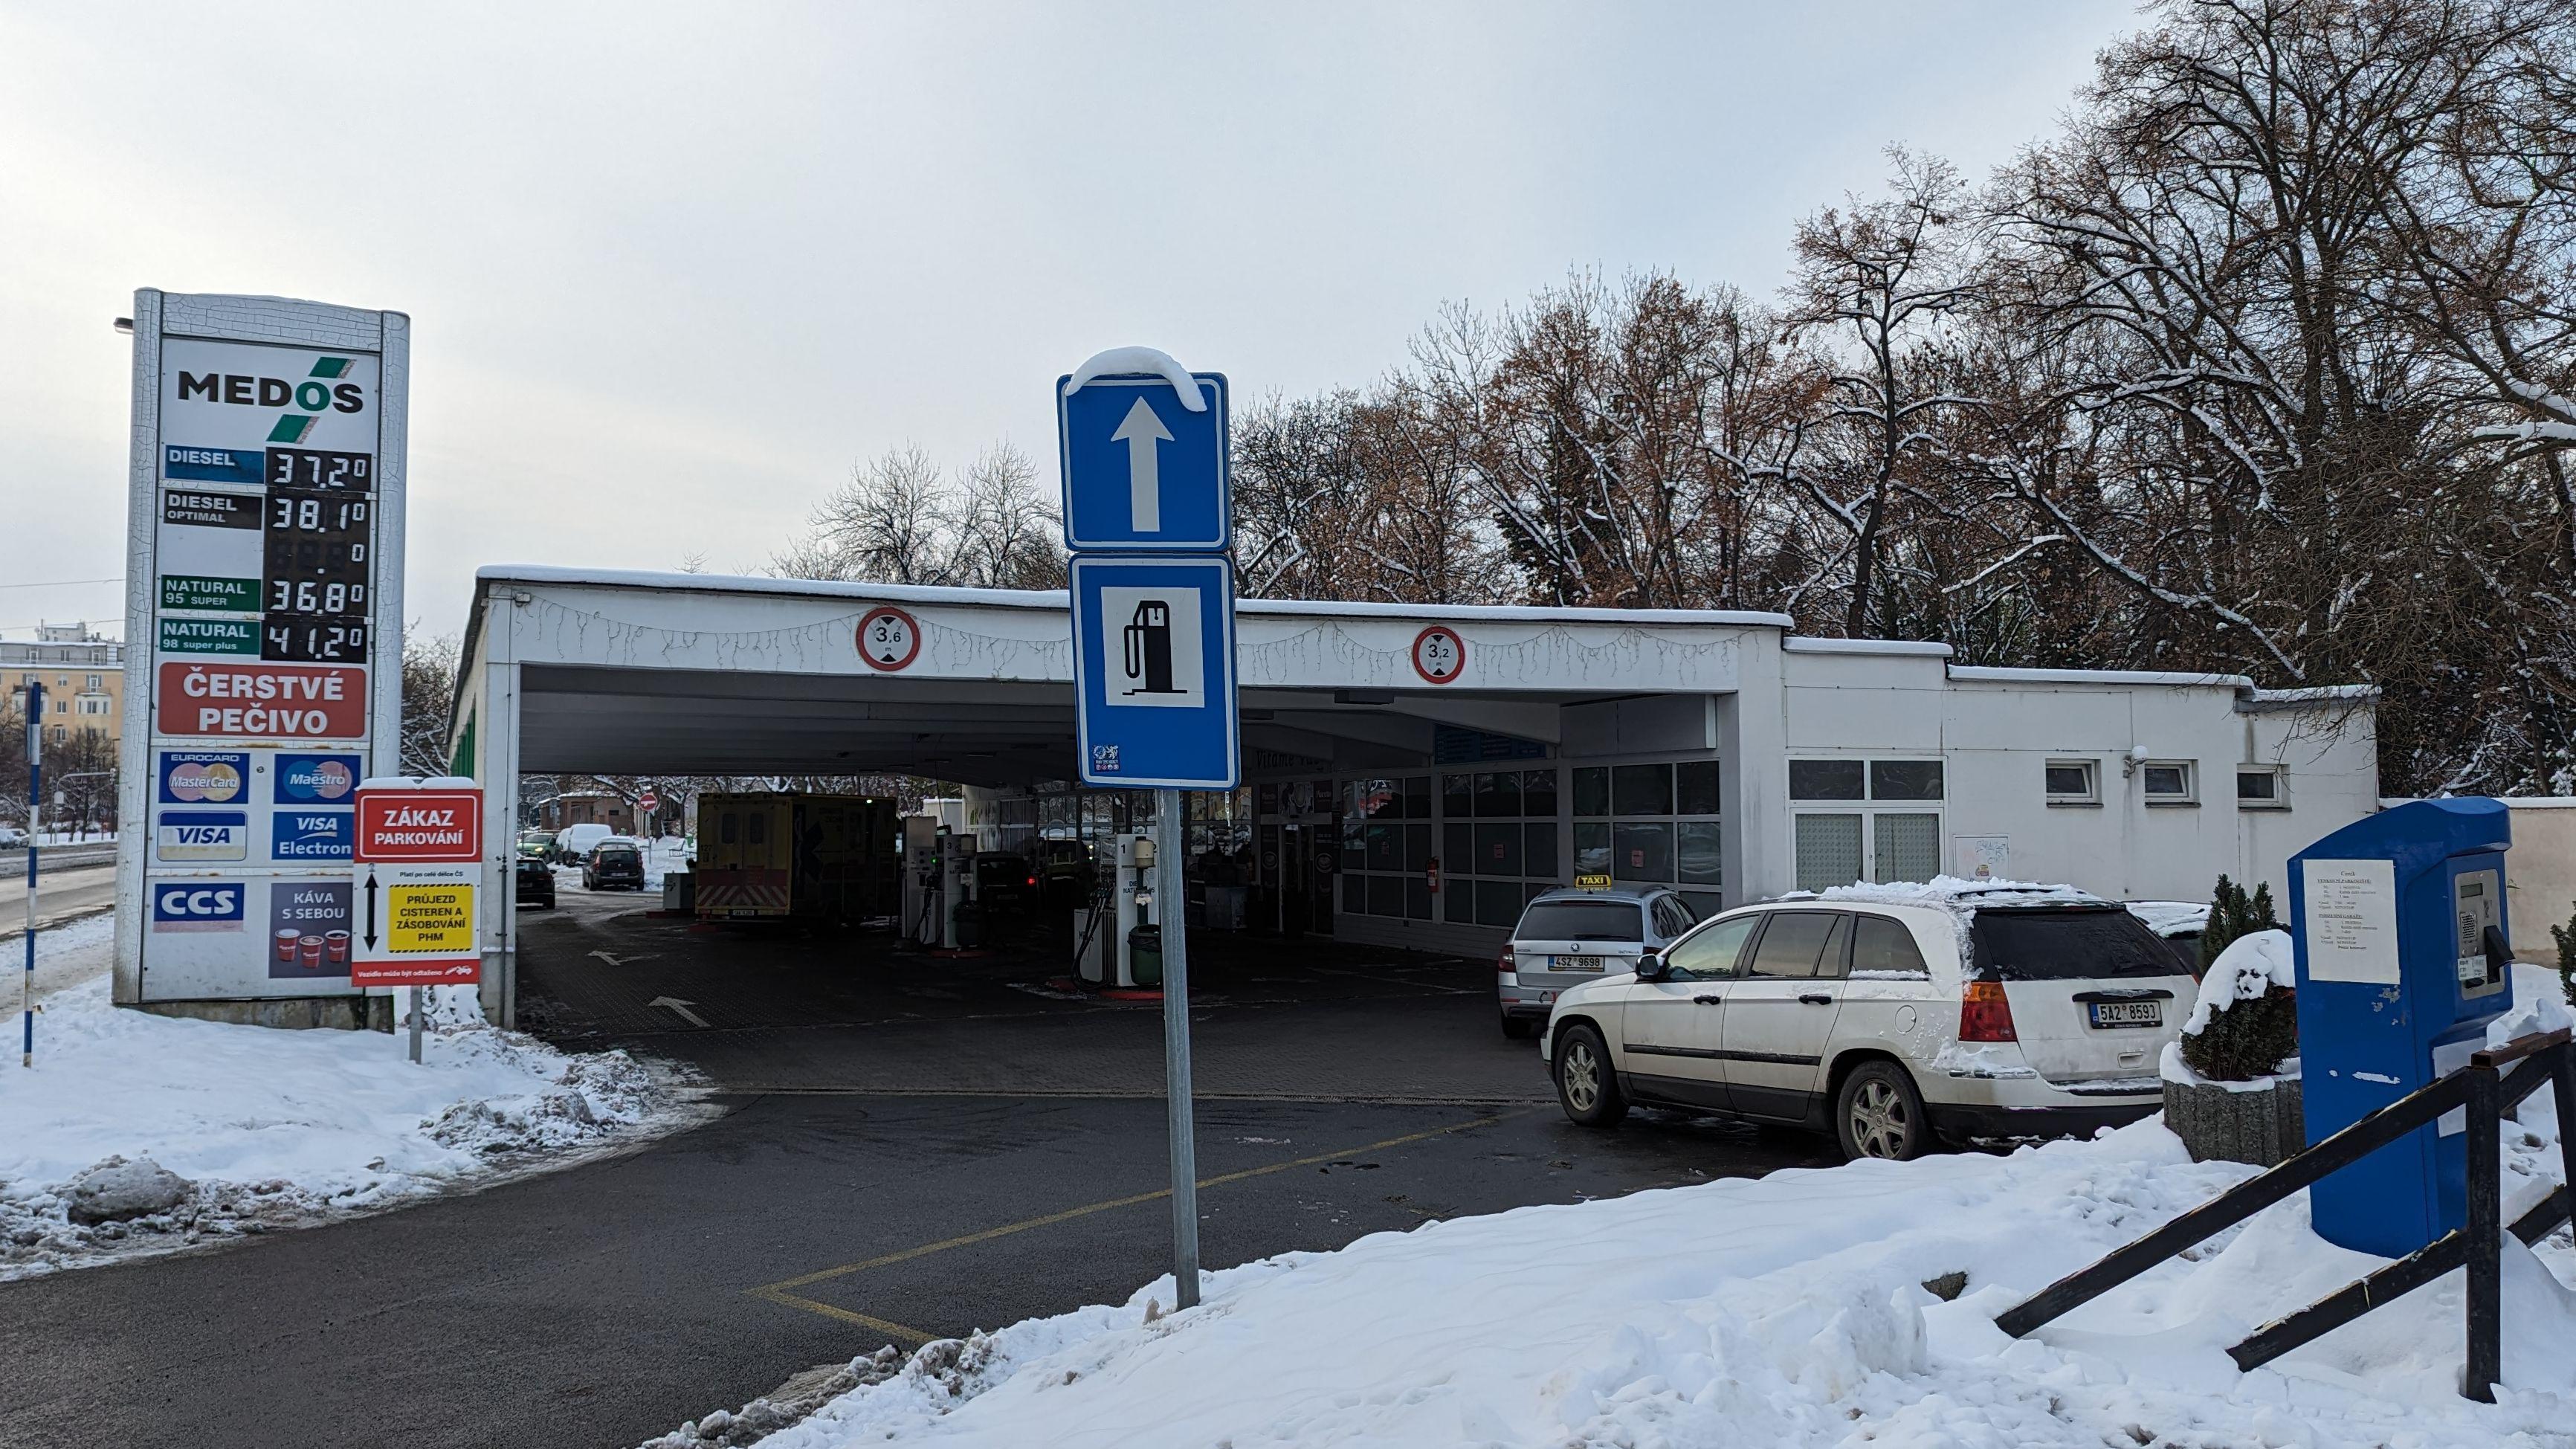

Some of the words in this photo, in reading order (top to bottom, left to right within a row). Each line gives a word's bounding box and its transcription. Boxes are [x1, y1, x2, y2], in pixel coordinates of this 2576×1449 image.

[178, 371, 364, 413] MEDOS
[169, 449, 235, 466] DIESEL
[168, 494, 238, 511] DIESEL
[167, 510, 226, 523] OPTIMAL
[166, 580, 246, 594] NATURAL
[166, 593, 184, 604] 95
[190, 597, 227, 606] SUPER
[164, 623, 250, 638] NATURAL
[876, 627, 901, 643] 3,6
[163, 639, 178, 648] 98
[183, 642, 213, 650] super
[215, 642, 237, 651] plus
[1428, 644, 1449, 659] 3,2
[184, 666, 344, 701] ČERSTVÉ
[198, 703, 328, 735] PEČIVO
[171, 754, 239, 762] EUROCARD
[170, 776, 239, 789] MasterCard
[289, 774, 346, 785] Maestro
[384, 806, 454, 827] ZÁKAZ
[296, 817, 338, 830] VISA
[175, 827, 230, 844] VISA
[375, 829, 464, 845] PARKOVÁNÍ
[279, 842, 352, 855] Electron
[1121, 844, 1126, 853] 1
[161, 891, 235, 914] CCS
[294, 890, 334, 903] KÁVA
[407, 894, 456, 903] PRŮJEZD
[283, 909, 291, 919] S
[296, 908, 344, 919] SEBOU
[400, 908, 452, 917] CISTEREN
[454, 907, 462, 916] A
[396, 917, 466, 929] ZÁSOBOVÁNÍ
[418, 933, 444, 941] PHM
[1555, 958, 1572, 966] 4SZ
[1578, 958, 1600, 966] 9698
[2100, 1005, 2122, 1021] 5A2
[2128, 1004, 2156, 1020] 8593
